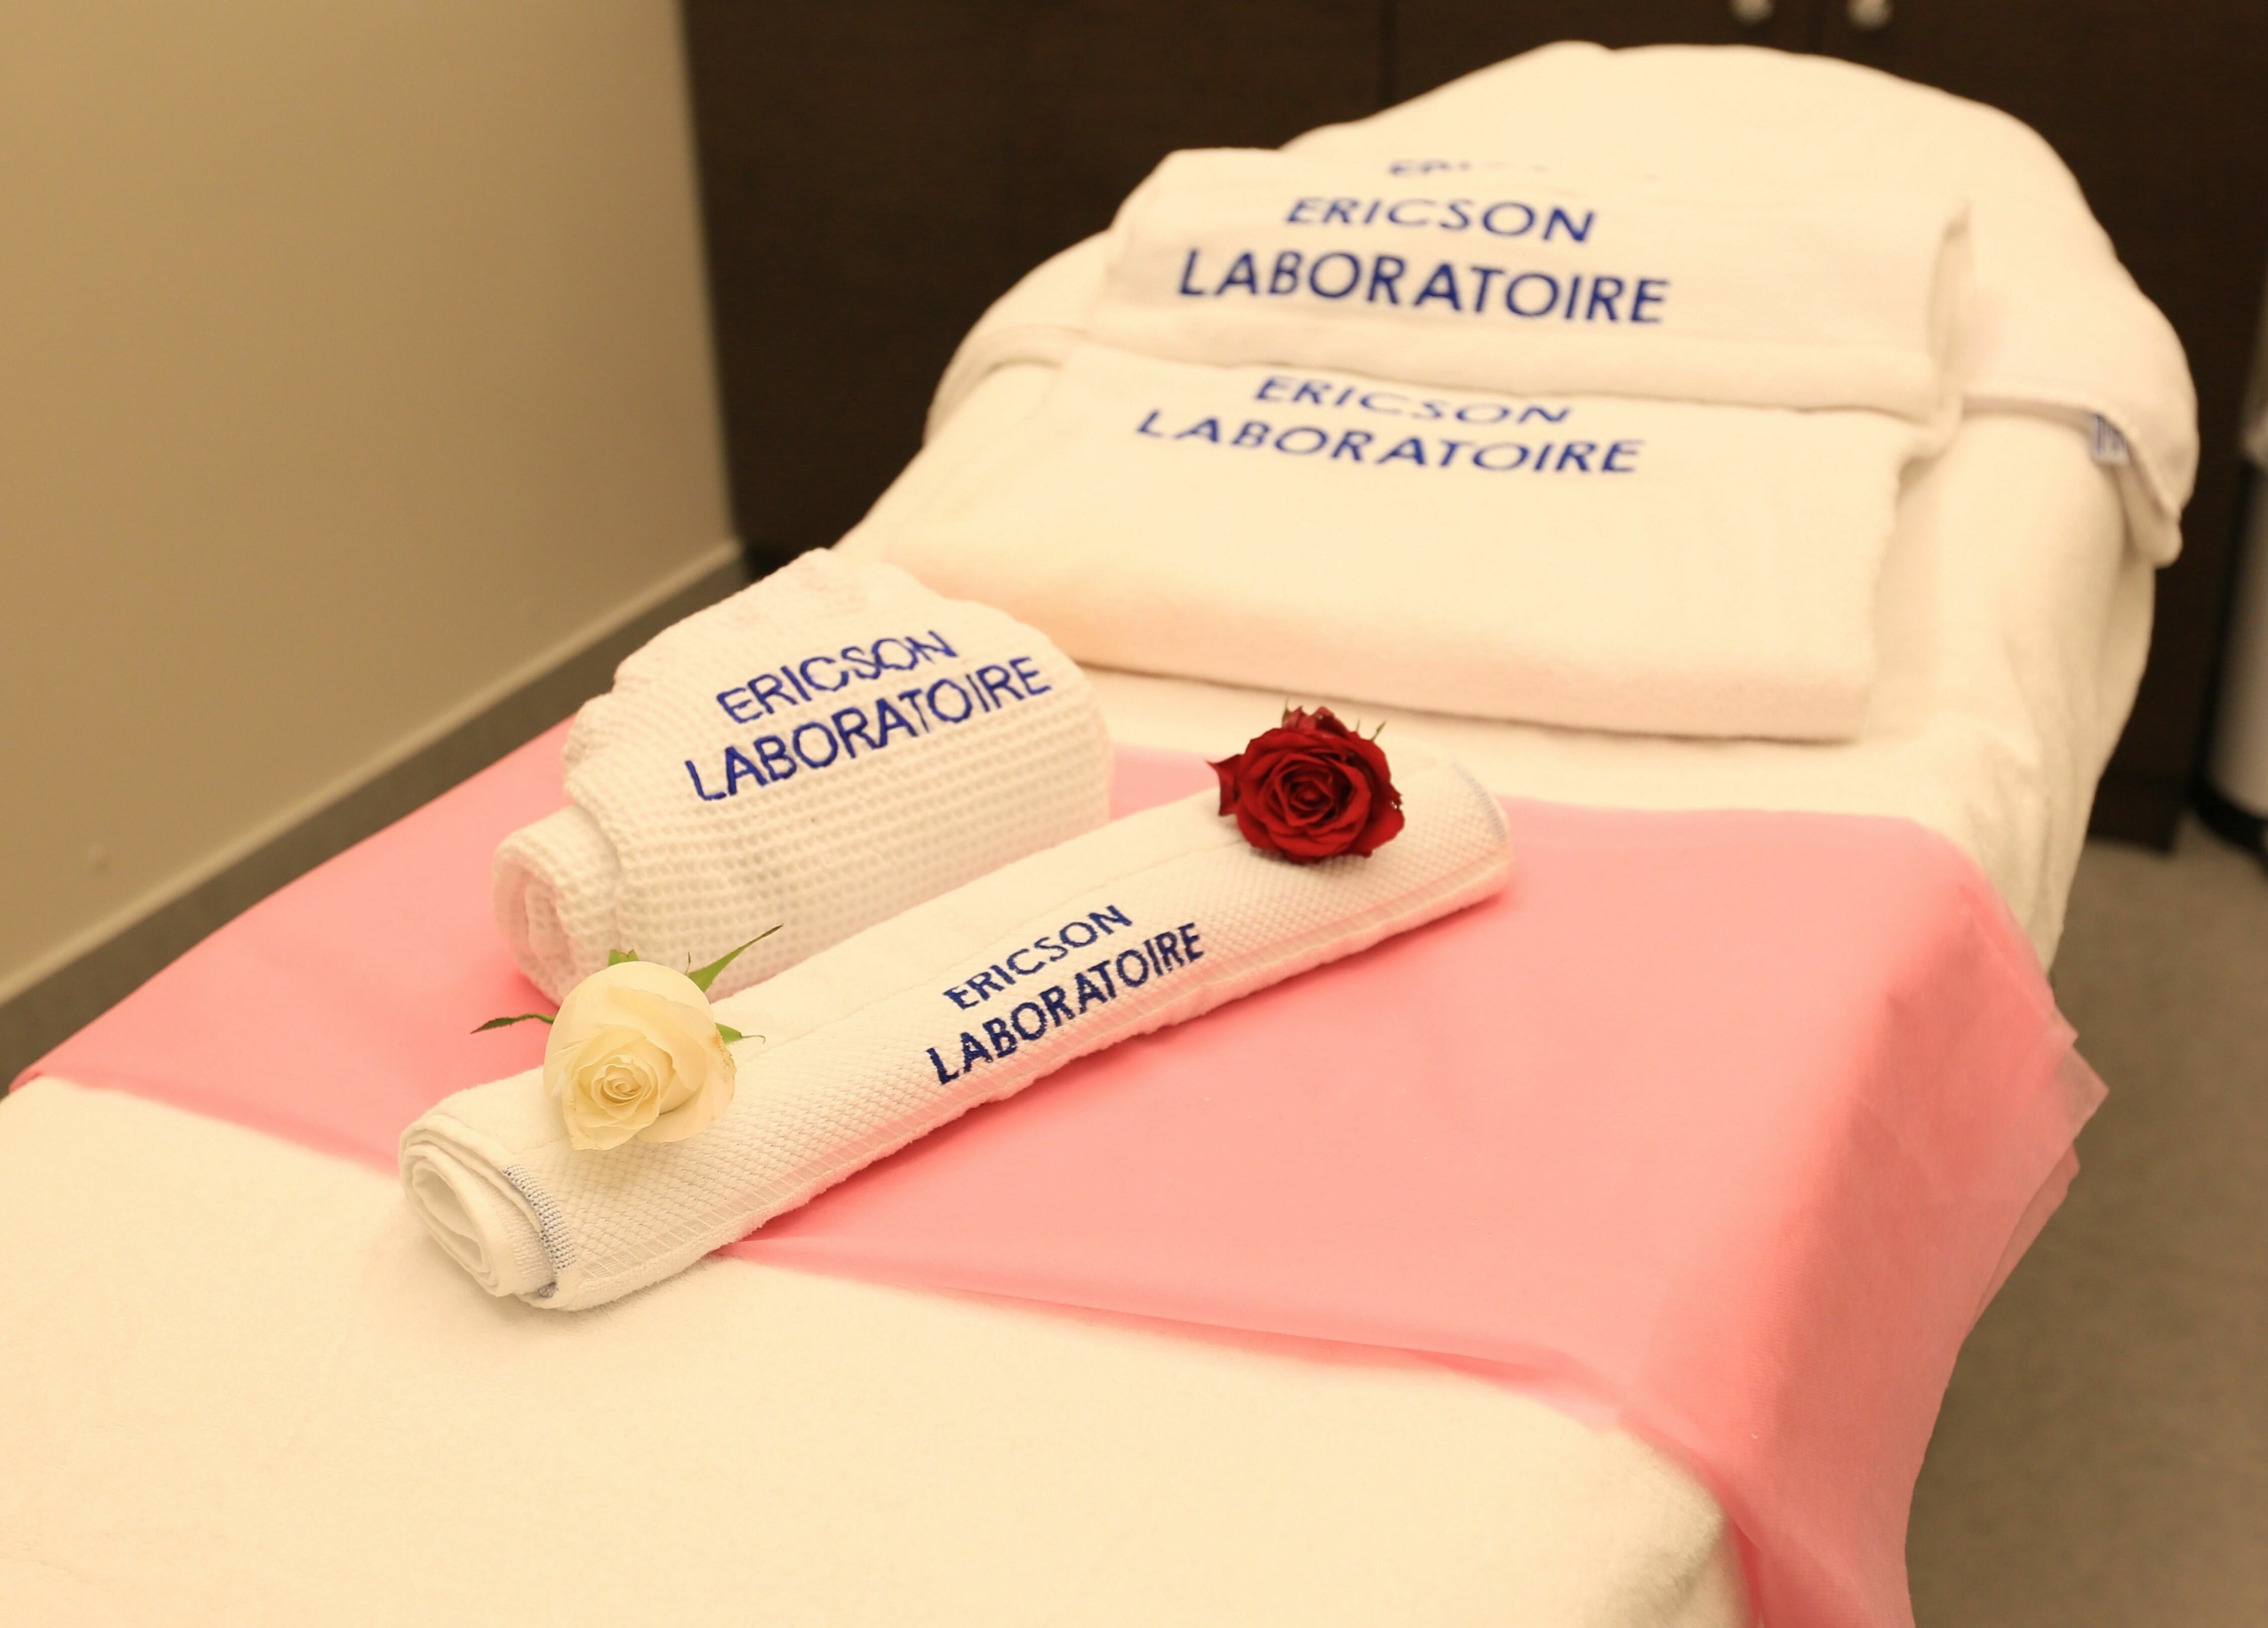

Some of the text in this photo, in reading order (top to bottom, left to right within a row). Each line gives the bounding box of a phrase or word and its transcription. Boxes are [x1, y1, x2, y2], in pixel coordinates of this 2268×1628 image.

[1285, 197, 1596, 242] ERICSON
[1178, 249, 1670, 323] LABORATOIRE
[1136, 410, 1645, 473] LABORATOIRE
[1254, 376, 1572, 424] ERICSON
[716, 630, 959, 724] ERICSON
[685, 656, 1051, 801] LABORATOIRE
[943, 904, 1132, 1010] ERICSON
[926, 922, 1204, 1085] LABORATOIRE
